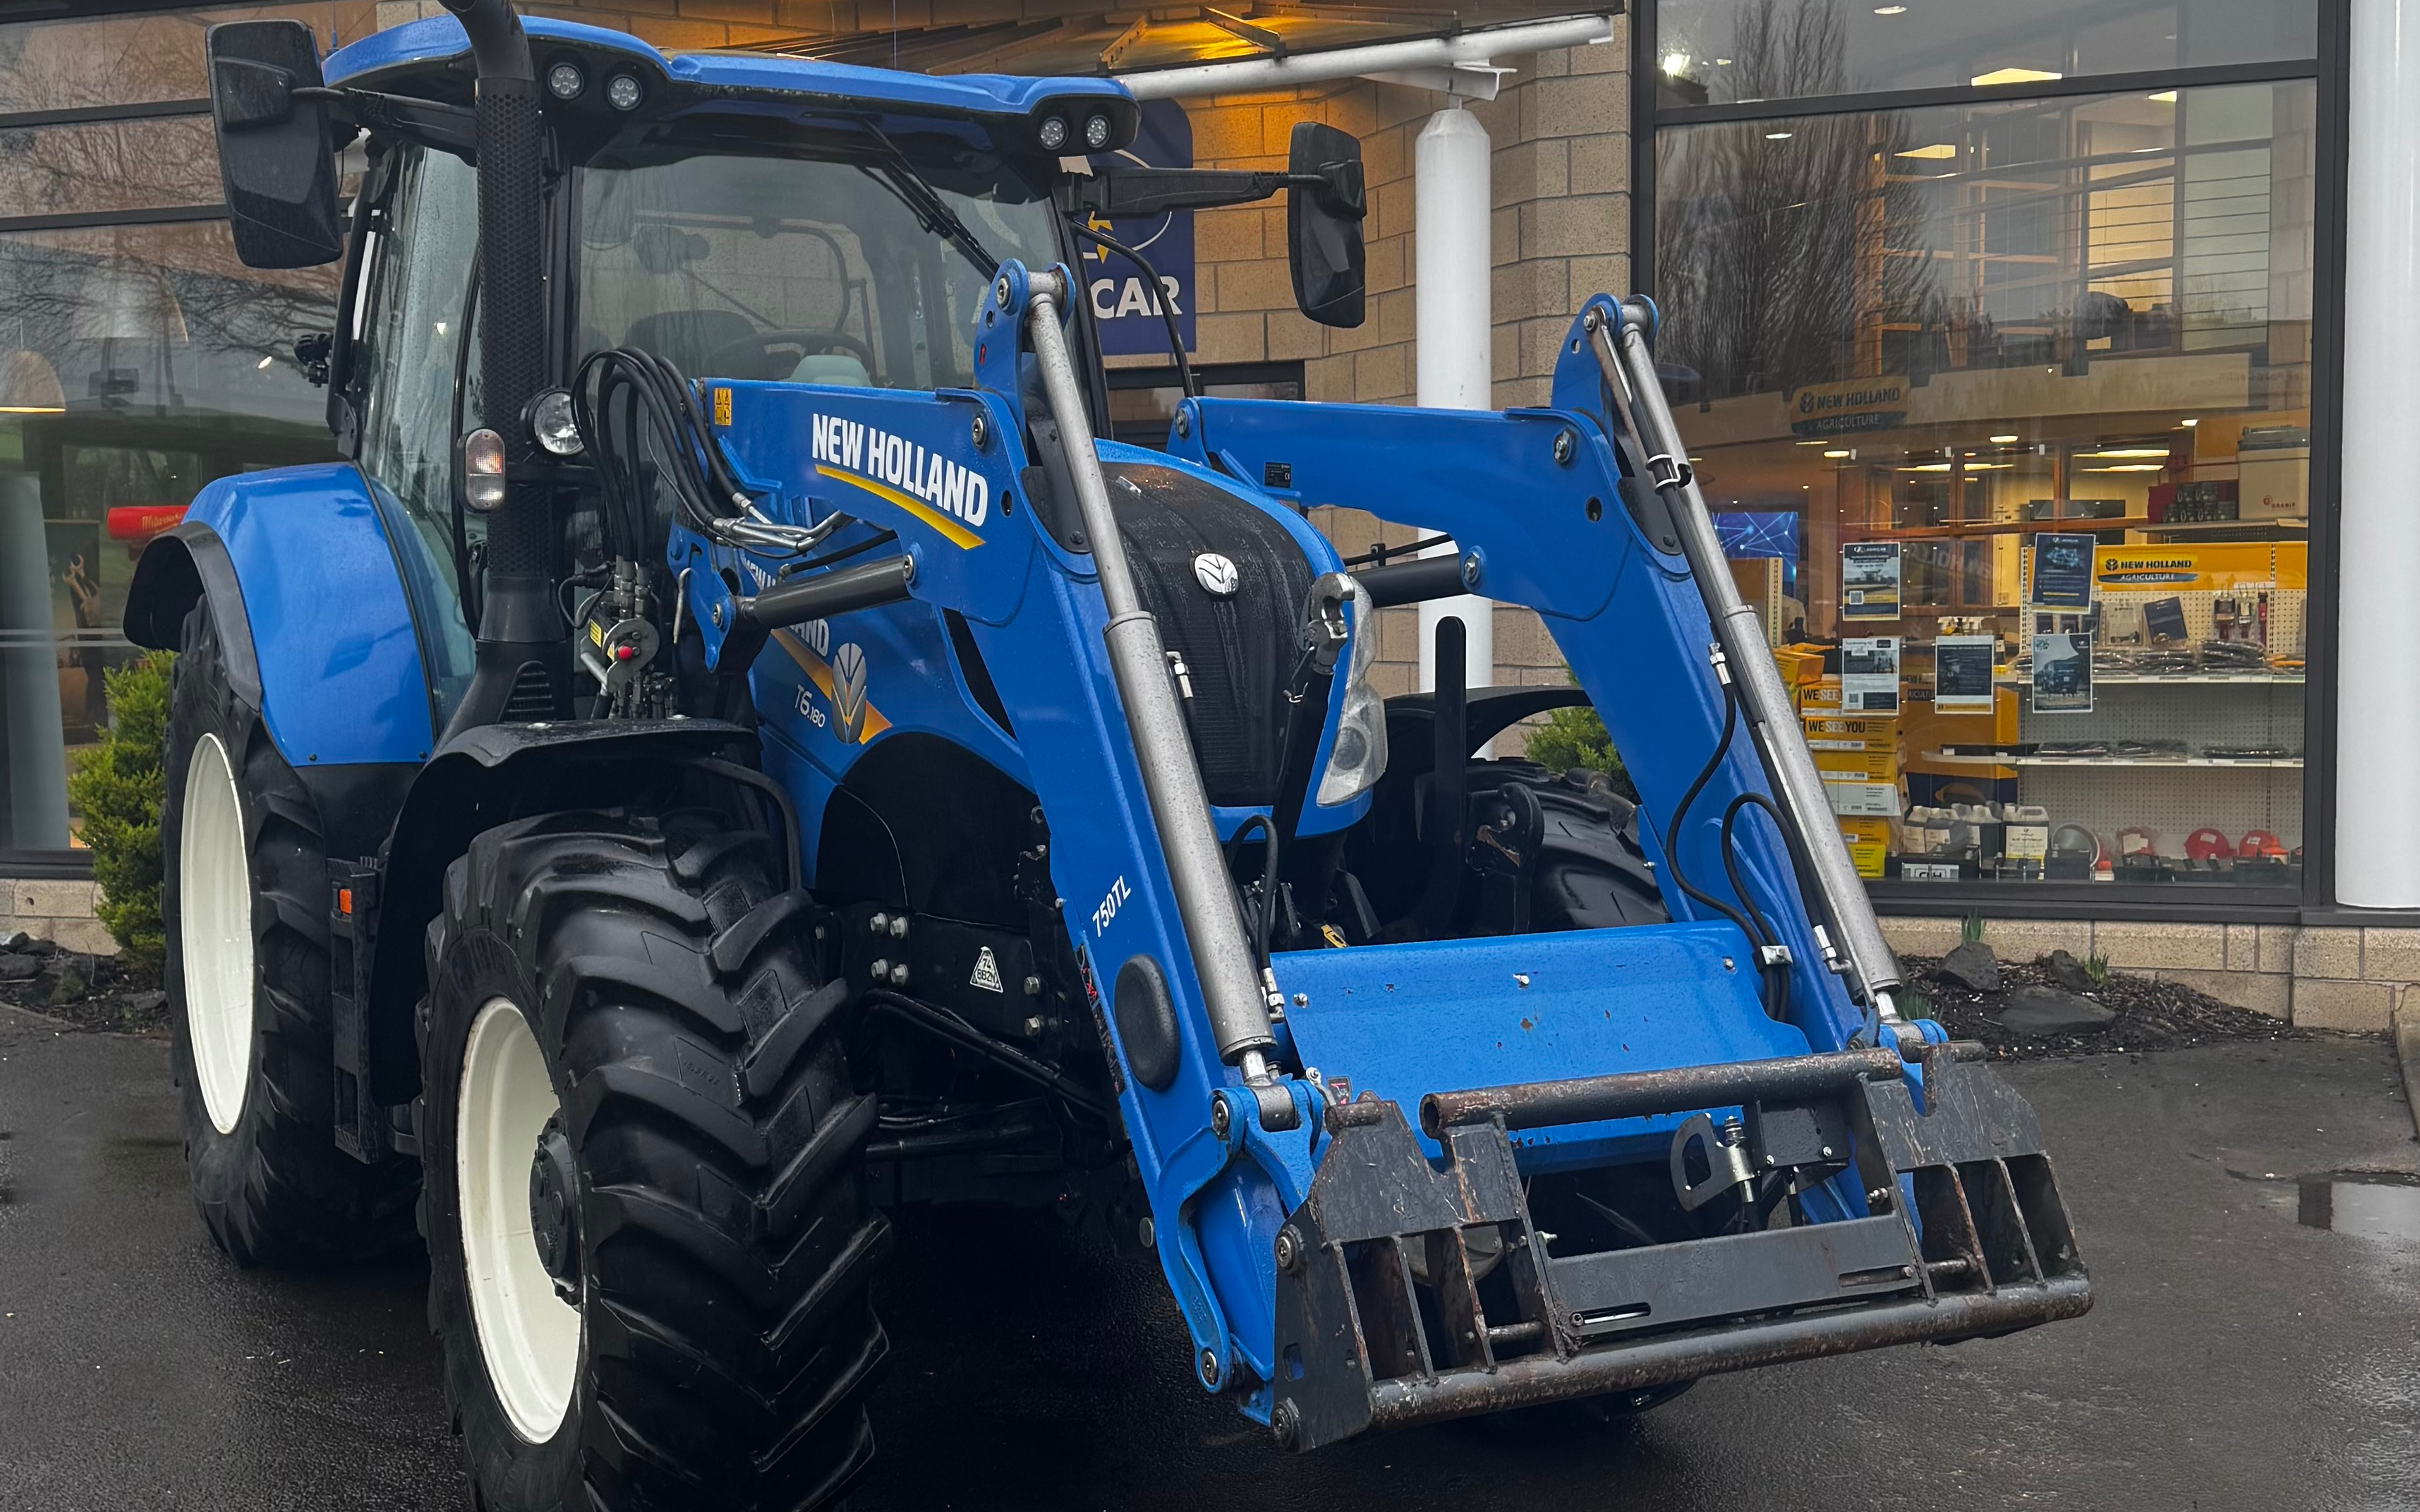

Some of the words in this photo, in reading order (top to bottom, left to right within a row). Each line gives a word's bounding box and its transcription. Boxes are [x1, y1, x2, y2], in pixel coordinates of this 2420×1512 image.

[1817, 393, 1843, 409] NEW
[1846, 388, 1901, 406] HOLLAND
[1817, 414, 1880, 430] AGRICULTURE
[812, 413, 864, 470] NEW
[868, 428, 988, 527] HOLLAND
[2120, 561, 2144, 569] NEW
[2146, 560, 2192, 569] HOLLAND
[1803, 689, 1819, 701] WE
[1820, 689, 1839, 701] SEE
[794, 684, 825, 728] T6.180
[1808, 720, 1824, 732] WE
[1825, 720, 1844, 732] SEE
[1846, 721, 1865, 733] YOU
[1091, 875, 1132, 938] 750TL
